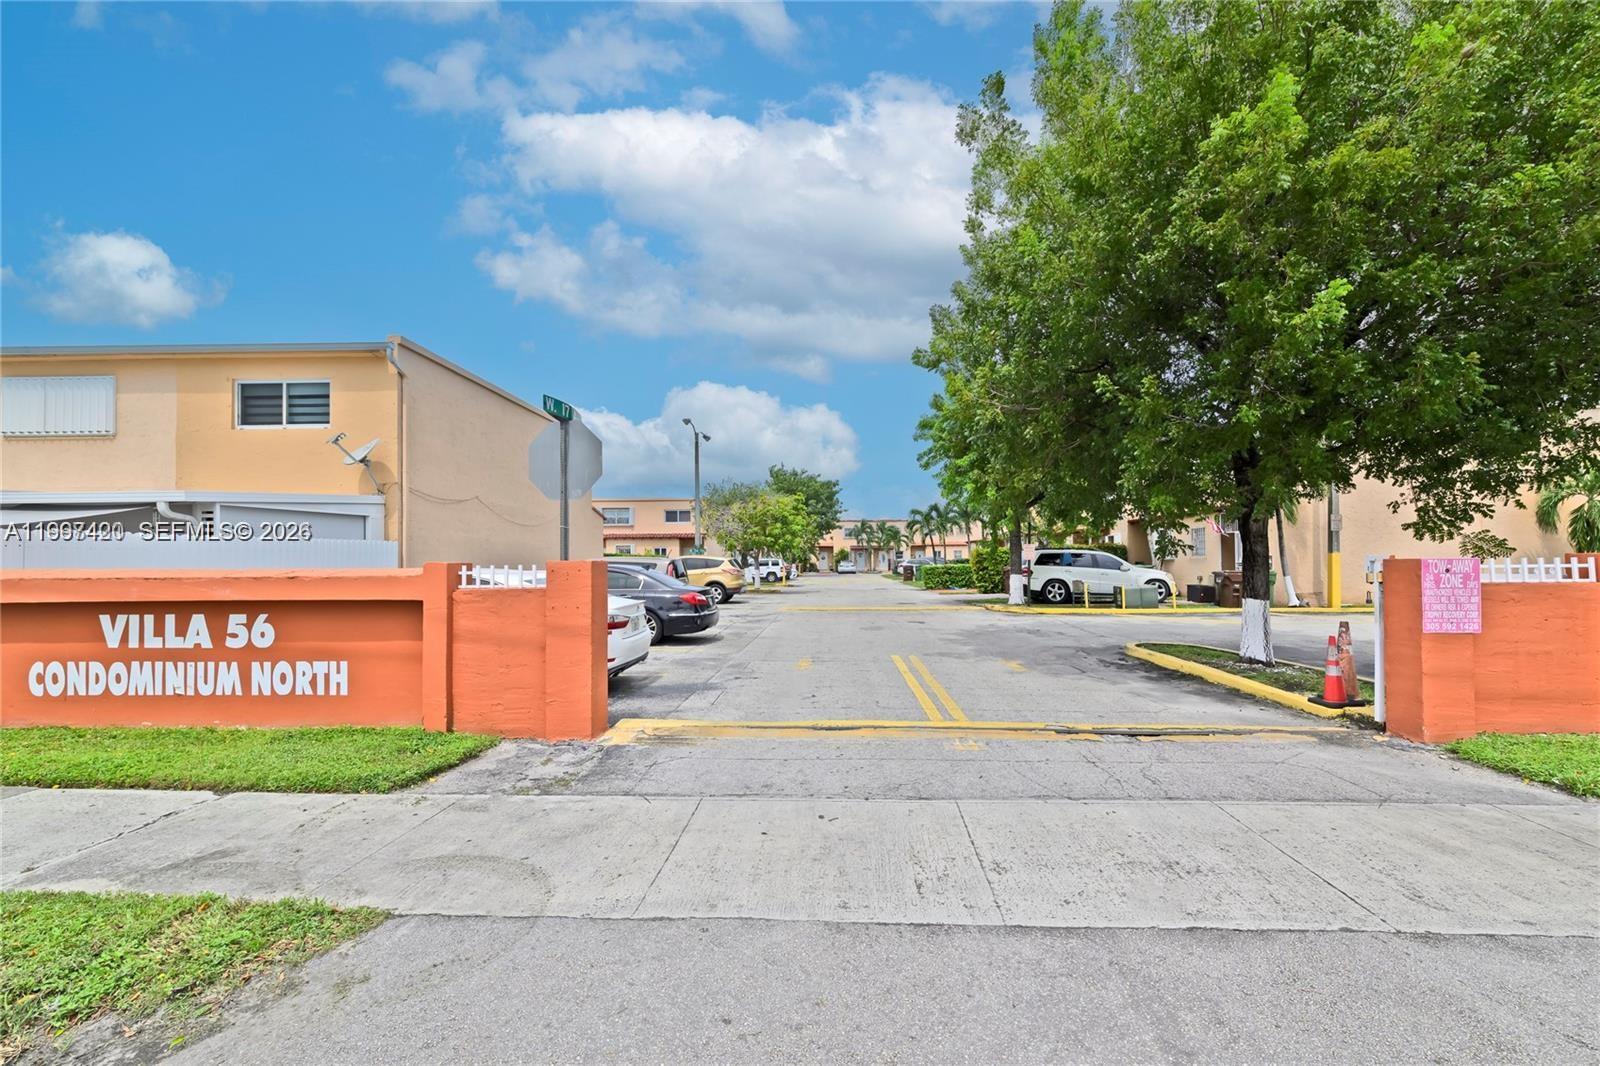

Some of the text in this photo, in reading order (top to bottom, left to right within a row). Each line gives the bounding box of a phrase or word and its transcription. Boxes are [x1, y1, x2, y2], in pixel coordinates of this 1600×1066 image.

[546, 396, 570, 418] W. 17
[1428, 560, 1474, 574] TOW-AWAY
[1440, 574, 1463, 588] ZONE
[98, 613, 275, 648] VILLA 56
[28, 660, 348, 697] CONDOMINIUM NORTH
